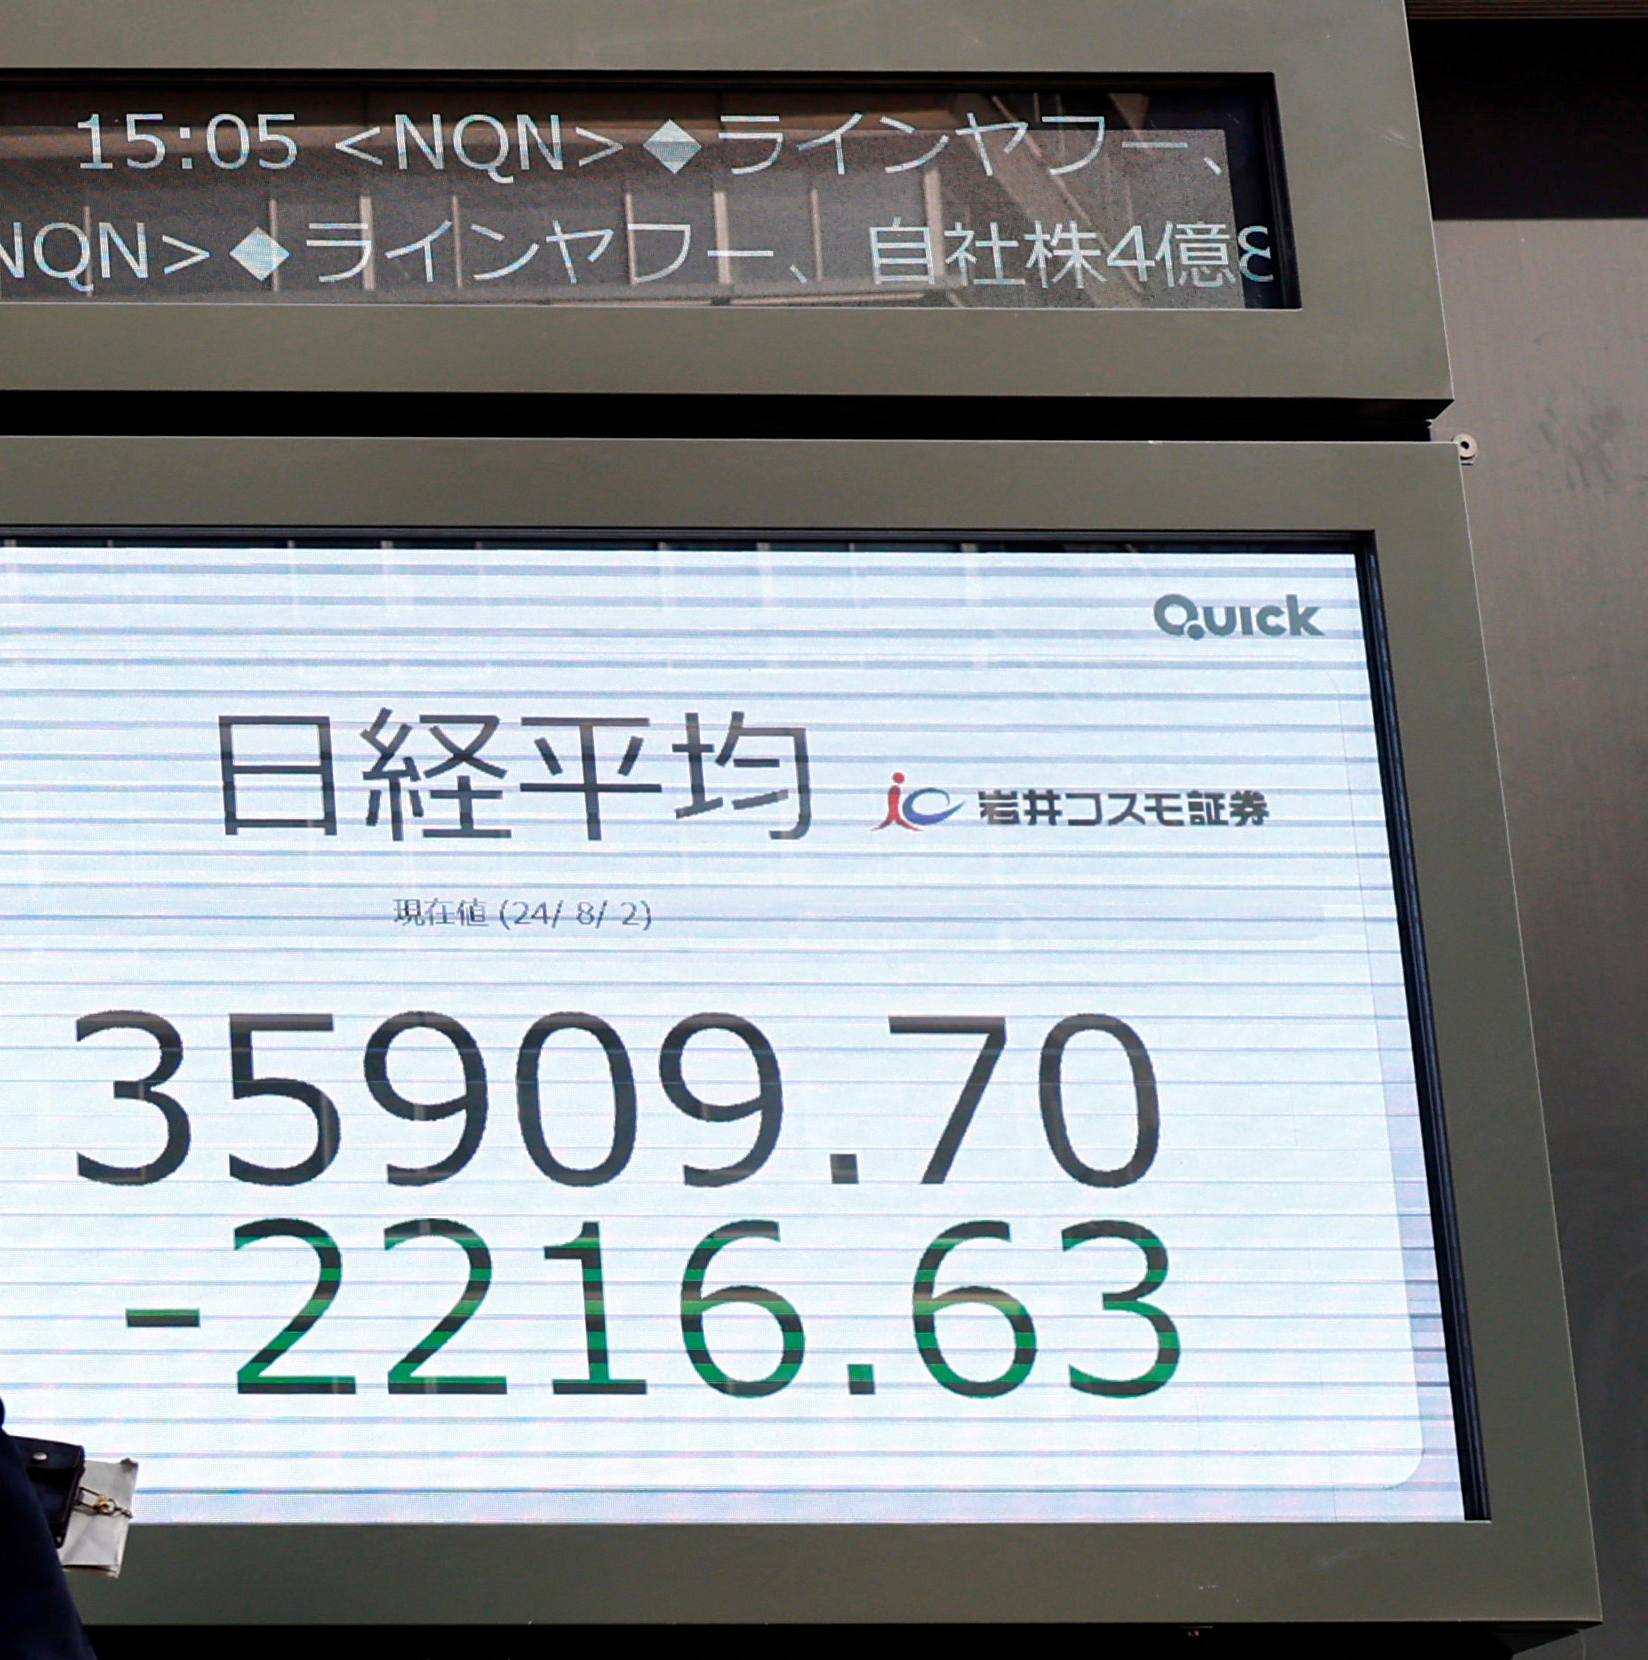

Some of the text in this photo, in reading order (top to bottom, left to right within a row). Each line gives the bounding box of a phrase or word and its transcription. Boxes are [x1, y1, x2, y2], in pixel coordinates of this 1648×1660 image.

[78, 113, 298, 170] 15:05
[335, 113, 624, 183] <NQN>
[217, 708, 811, 843] 日経平均
[977, 789, 1269, 828] 岩井コスモ証券
[74, 1011, 1162, 1189] 35909.70
[125, 1220, 1181, 1399] -2216.63
